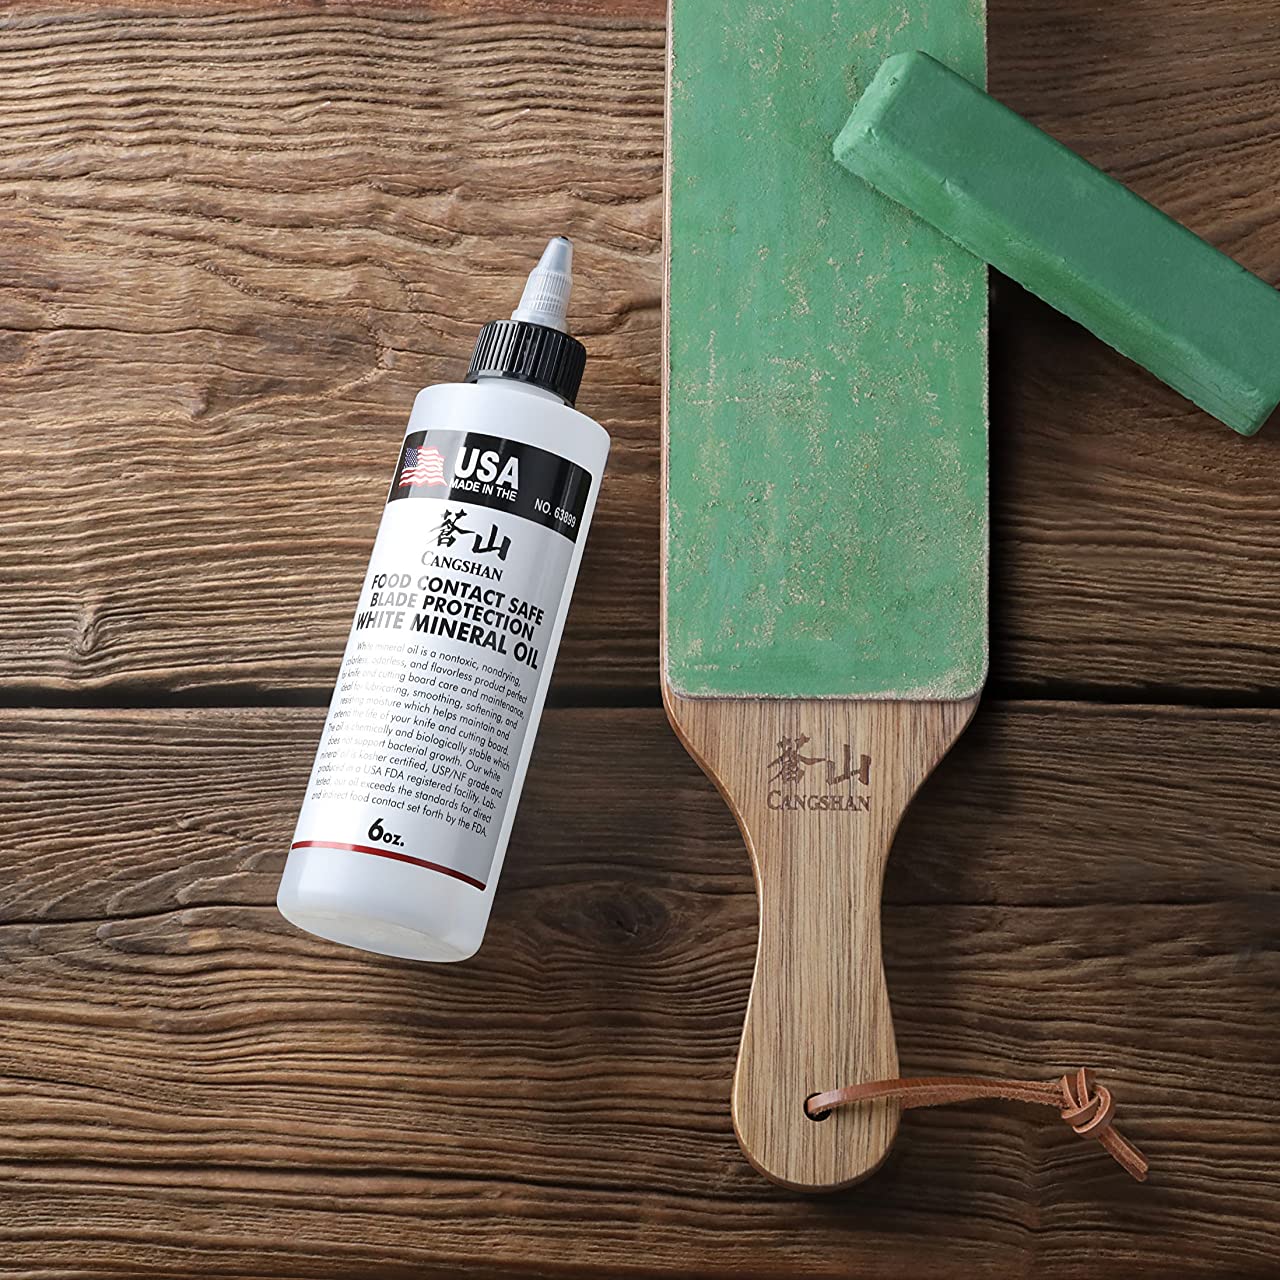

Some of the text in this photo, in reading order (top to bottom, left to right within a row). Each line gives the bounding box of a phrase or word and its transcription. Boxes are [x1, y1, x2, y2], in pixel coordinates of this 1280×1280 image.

[449, 478, 518, 502] MADE IN THE
[454, 447, 520, 490] USA
[535, 498, 576, 528] NO. 63899
[421, 550, 503, 582] CANGSHAN
[370, 592, 535, 641] BLADE PROTECTION
[371, 574, 545, 626] FOOD CONTACT SAFE
[356, 611, 539, 670] WHITE MINERAL OIL
[407, 644, 419, 654] oil
[420, 646, 427, 656] is
[439, 652, 479, 671] nontoxic,
[482, 664, 520, 687] nondrying,
[410, 661, 428, 670] and
[431, 661, 472, 682] flavorless
[474, 676, 505, 693] product
[506, 688, 527, 704] perfect
[408, 672, 436, 686] board
[439, 681, 458, 692] care
[460, 686, 479, 698] and
[480, 693, 524, 720] maintenance,
[413, 689, 462, 709] smoothing,
[465, 703, 503, 724] softening,
[505, 718, 519, 729] and
[390, 714, 411, 724] your
[413, 715, 436, 729] knife
[438, 724, 457, 735] and
[458, 730, 486, 747] cutting
[487, 737, 509, 756] board.
[404, 700, 430, 713] which
[433, 705, 457, 721] helps
[459, 715, 495, 734] maintain
[497, 729, 511, 740] and
[387, 738, 428, 756] bacterial
[429, 750, 462, 768] growth.
[465, 759, 482, 773] Our
[483, 768, 501, 782] white
[395, 728, 414, 738] and
[415, 730, 467, 755] biologically
[469, 748, 492, 762] stable
[493, 756, 510, 772] which
[363, 764, 382, 776] USA
[384, 767, 404, 780] FDA
[406, 773, 452, 793] registered
[454, 785, 480, 804] facility.
[482, 796, 496, 809] Lab-
[389, 756, 428, 773] certified,
[431, 763, 467, 782] USP/NF
[467, 777, 489, 793] grade
[491, 788, 504, 799] and
[350, 791, 370, 802] food
[371, 795, 405, 809] contact
[406, 802, 420, 813] set
[422, 804, 444, 820] forth
[445, 812, 456, 826] by
[458, 817, 470, 829] the
[360, 781, 395, 793] exceeds
[398, 785, 413, 797] the
[415, 790, 459, 810] standards
[460, 802, 472, 815] for
[473, 807, 492, 823] direct
[767, 790, 871, 812] CANGSHAN
[368, 818, 404, 847] 6oz.
